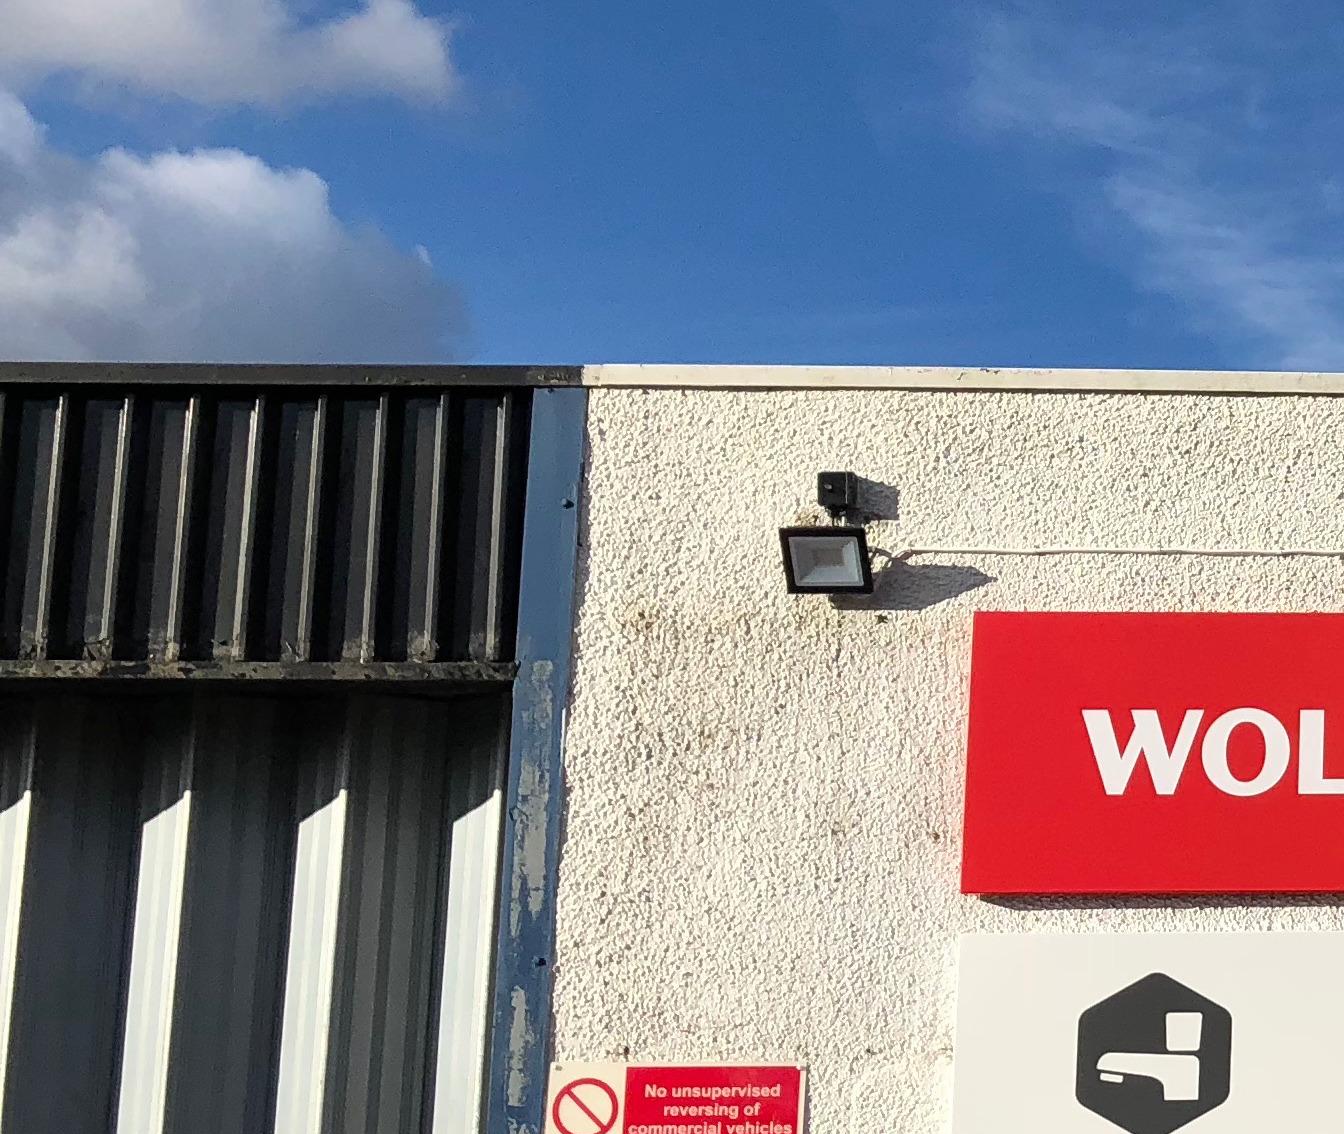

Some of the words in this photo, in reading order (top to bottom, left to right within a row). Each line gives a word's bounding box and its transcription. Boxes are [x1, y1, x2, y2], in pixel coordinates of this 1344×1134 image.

[644, 1084, 667, 1098] No
[671, 1083, 781, 1101] unsupervised
[663, 1102, 740, 1120] reversing
[743, 1102, 762, 1117] of
